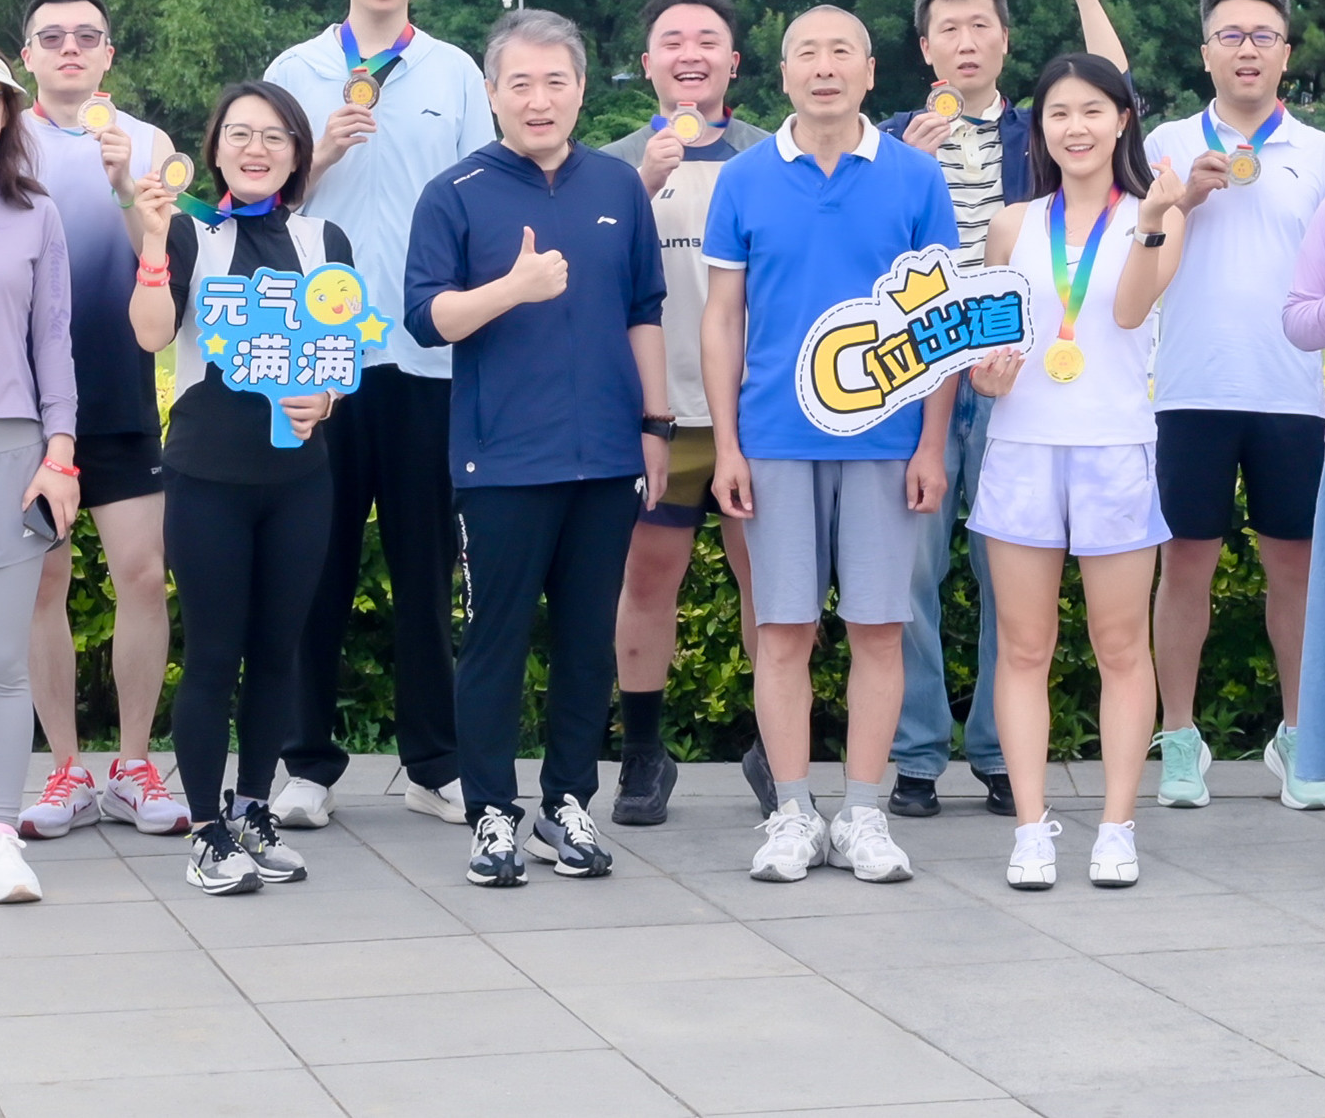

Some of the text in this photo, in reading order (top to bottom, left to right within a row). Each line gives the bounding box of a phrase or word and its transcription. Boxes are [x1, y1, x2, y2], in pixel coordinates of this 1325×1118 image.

[202, 274, 302, 330] 元气
[230, 333, 356, 386] 满满
[811, 291, 1024, 414] C位出道
